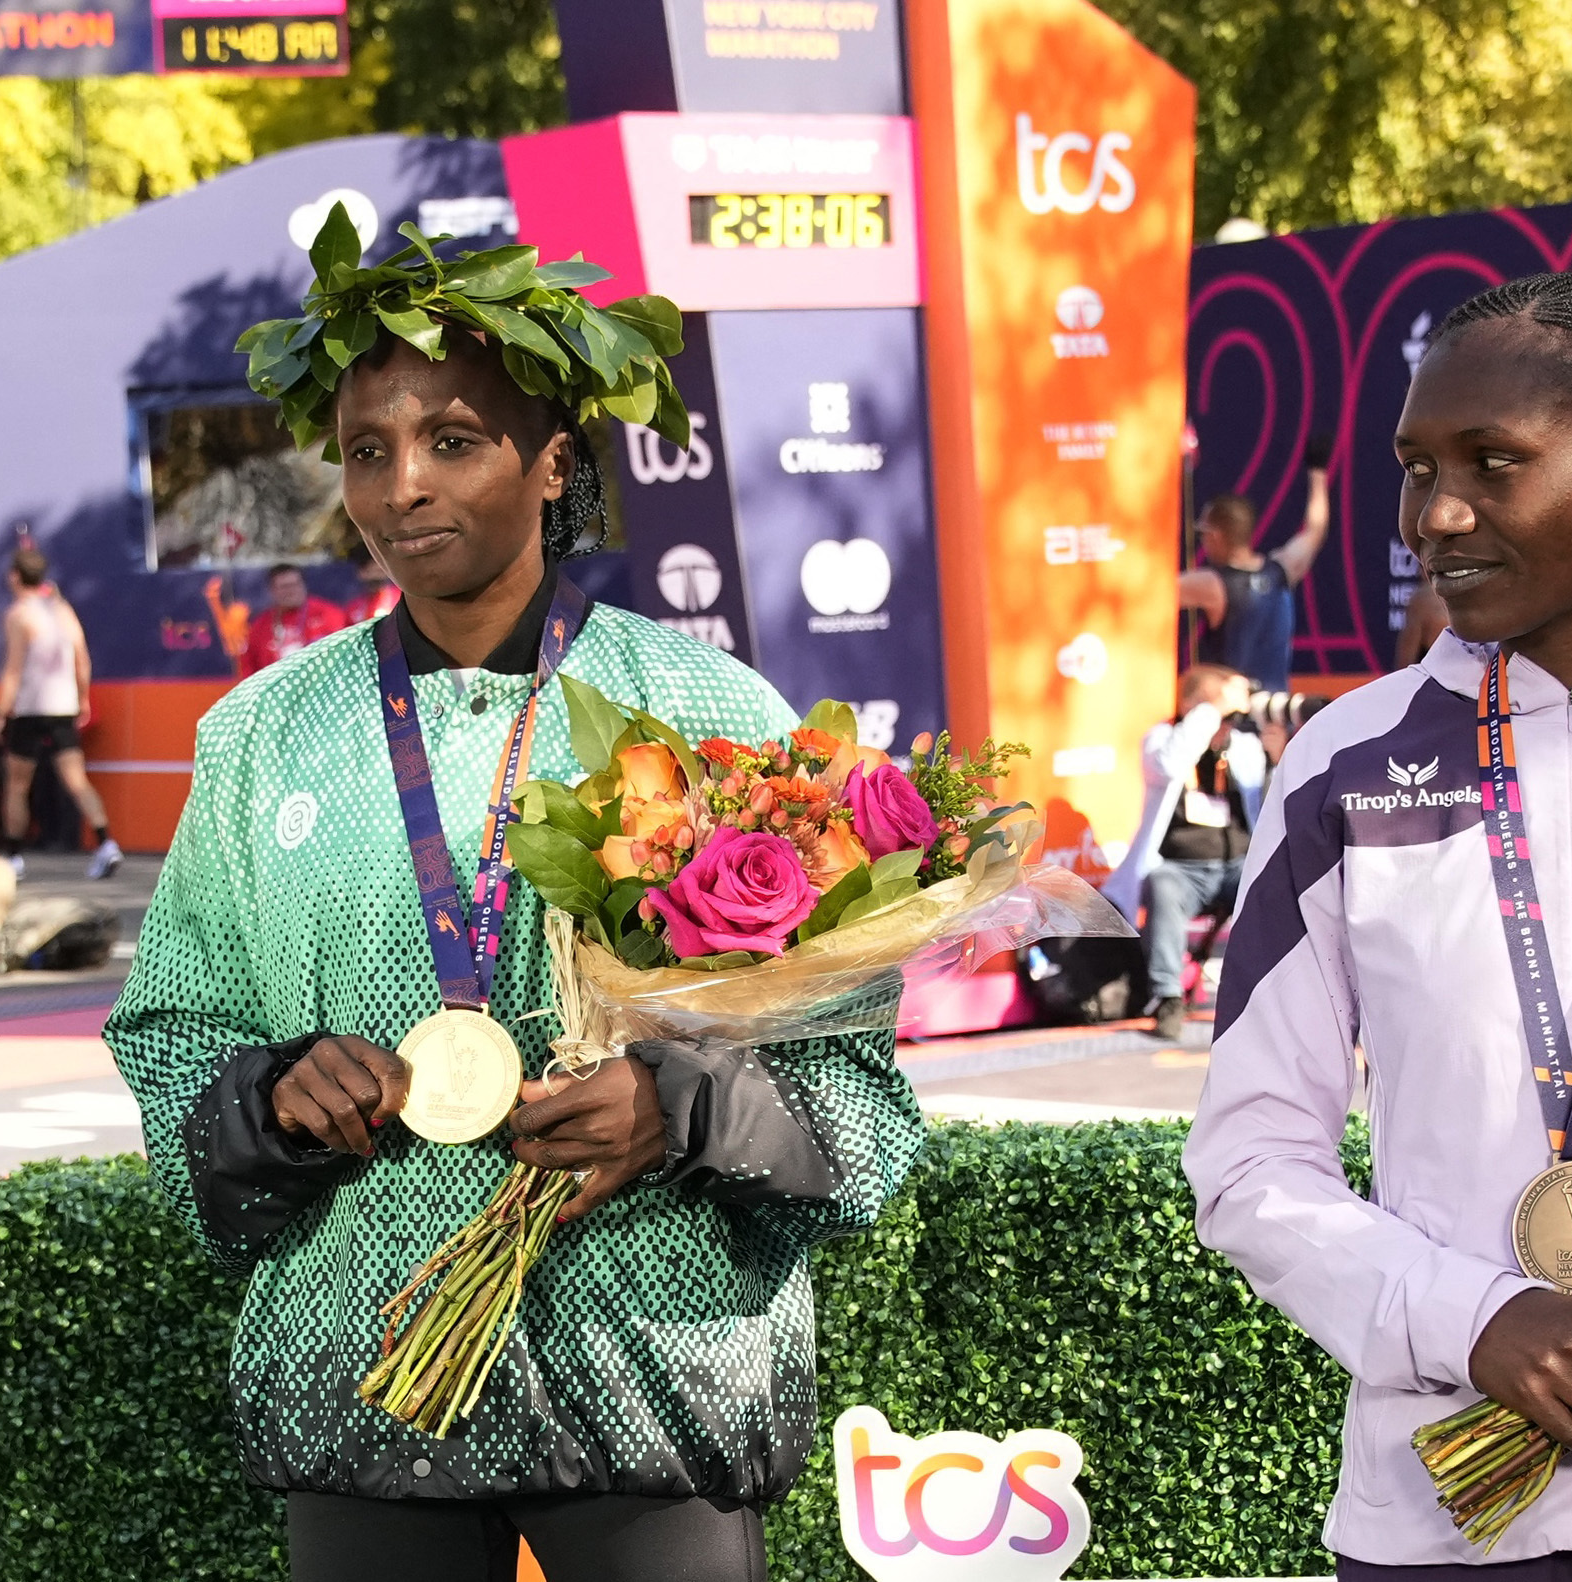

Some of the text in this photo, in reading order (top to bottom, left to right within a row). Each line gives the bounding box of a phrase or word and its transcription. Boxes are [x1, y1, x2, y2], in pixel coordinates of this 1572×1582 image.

[283, 21, 338, 60] AM
[1016, 111, 1136, 215] tcs
[502, 745, 518, 795] ISLAND
[1341, 785, 1483, 814] Tirop's Angels
[486, 812, 507, 888] BROOKLYN
[475, 906, 492, 962] QUEENS
[1489, 718, 1504, 792] BROOKLYN
[1497, 810, 1517, 870] QUEENS
[1512, 890, 1528, 920] THE
[1520, 927, 1542, 980] BRONX
[1535, 1000, 1567, 1100] MANHATTAN
[852, 1426, 1070, 1556] tcs
